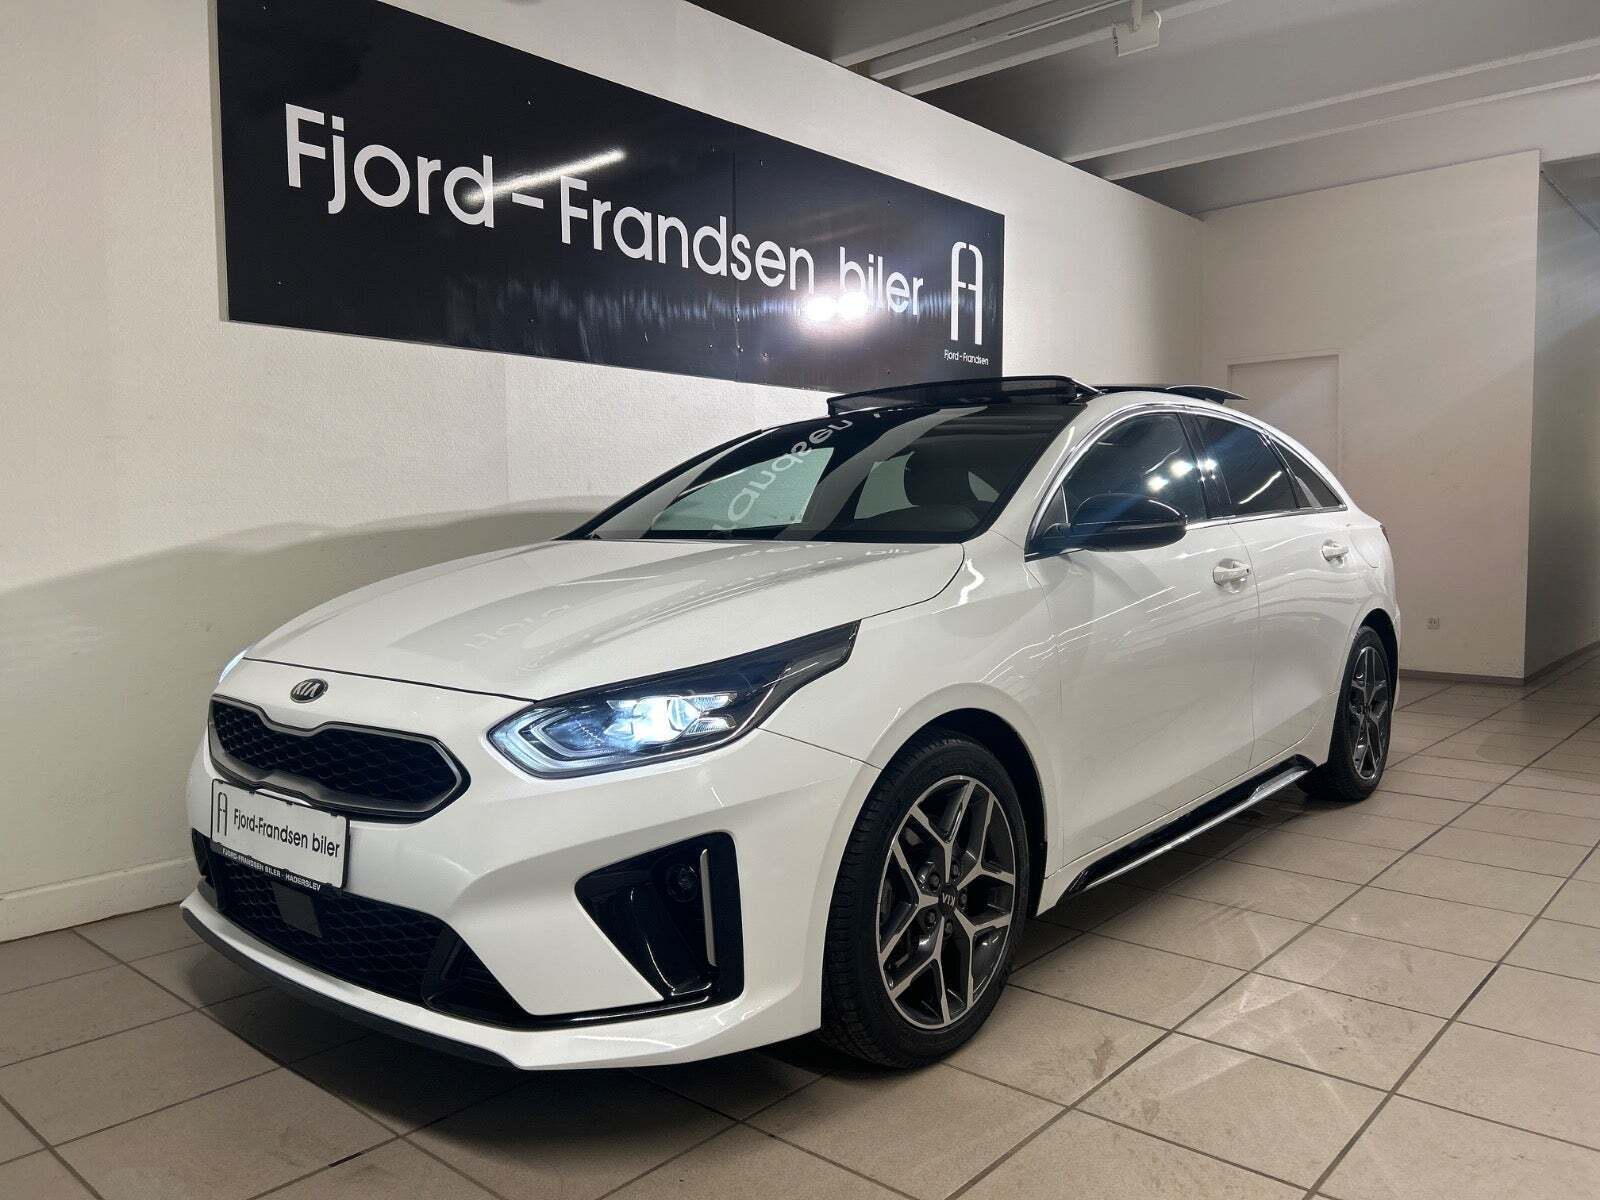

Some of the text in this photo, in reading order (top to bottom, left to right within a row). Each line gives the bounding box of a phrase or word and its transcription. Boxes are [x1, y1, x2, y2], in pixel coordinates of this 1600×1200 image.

[286, 103, 495, 228] Fjord
[561, 176, 815, 294] Frandsen
[840, 246, 924, 316] biler
[312, 832, 341, 858] biler
